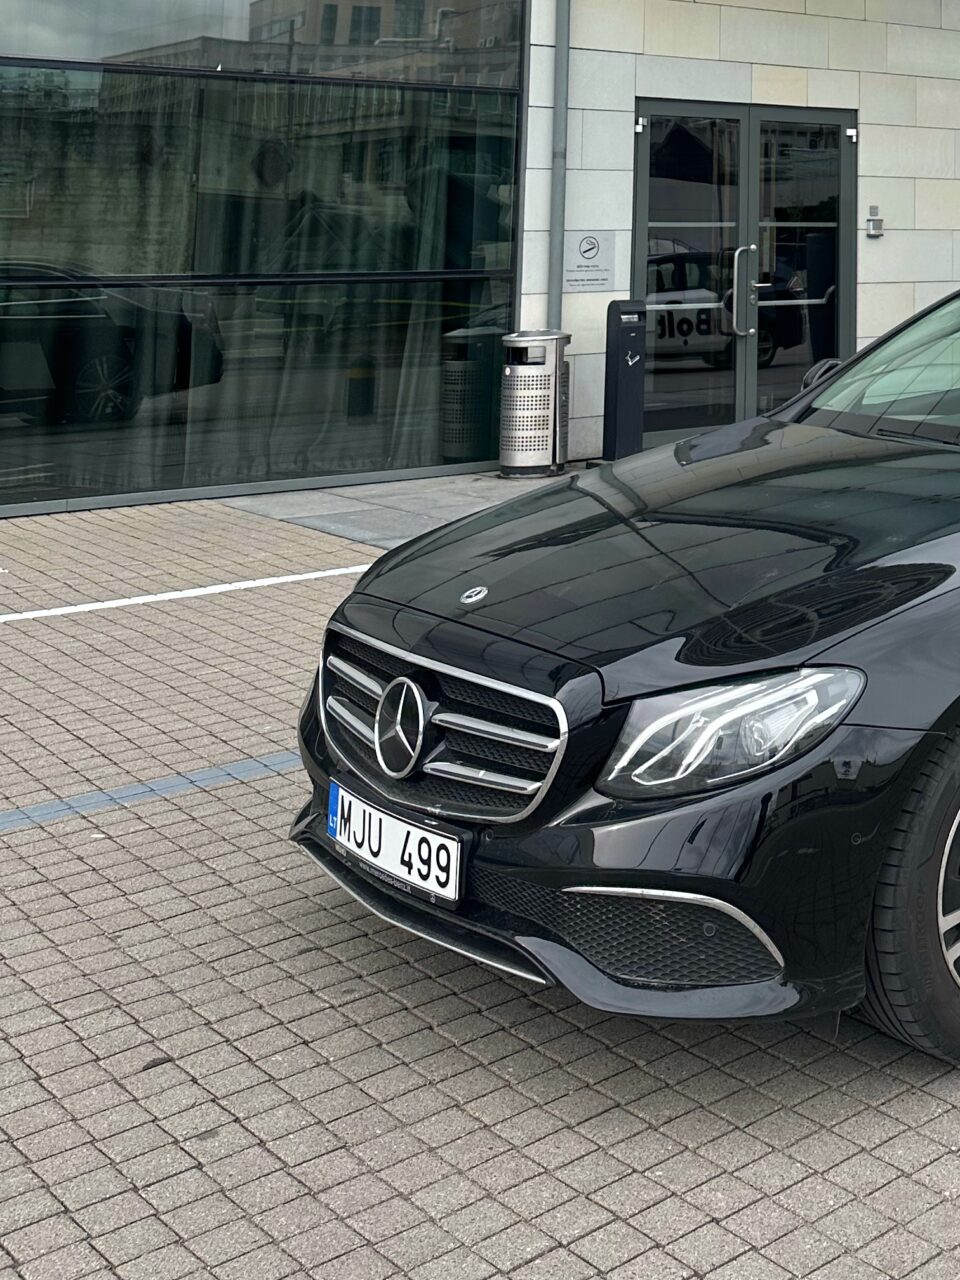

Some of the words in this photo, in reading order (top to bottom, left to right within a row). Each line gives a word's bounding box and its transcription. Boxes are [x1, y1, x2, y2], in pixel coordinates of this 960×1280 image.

[329, 815, 337, 829] LT
[339, 794, 382, 858] MJU
[400, 830, 450, 888] 499
